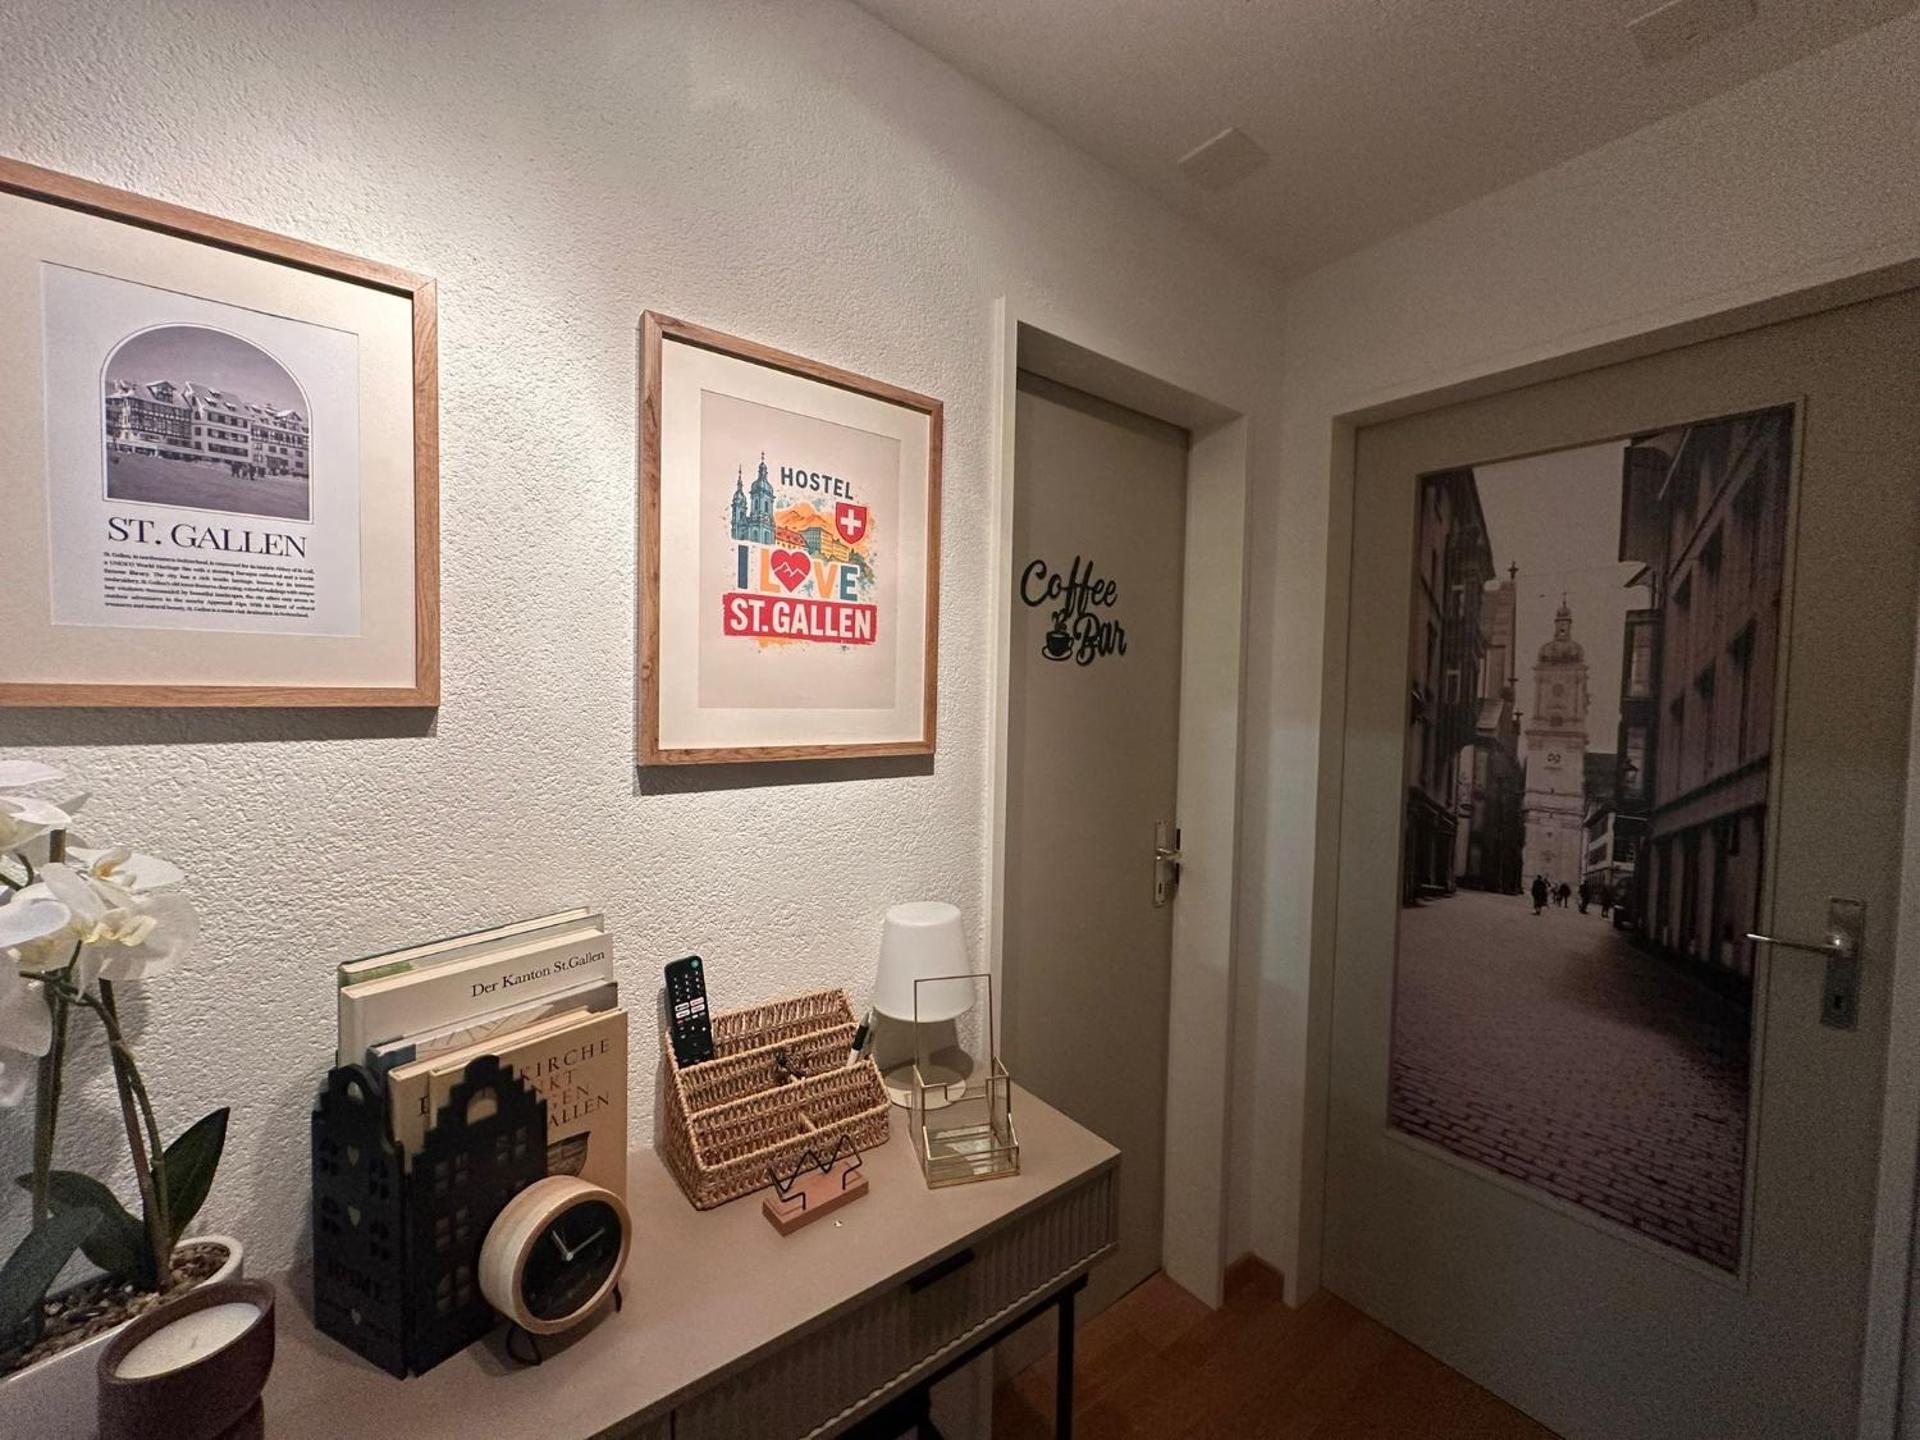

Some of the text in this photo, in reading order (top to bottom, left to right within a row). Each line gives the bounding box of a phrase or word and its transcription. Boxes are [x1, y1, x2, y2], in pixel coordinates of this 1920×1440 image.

[781, 466, 854, 500] HOSTEL
[108, 516, 308, 558] ST. GALLEN
[737, 545, 749, 589] I
[1020, 555, 1118, 618] Coffee
[1073, 613, 1127, 666] Bar
[472, 982, 499, 997] Der
[502, 968, 550, 989] Kanton
[550, 1091, 609, 1127] ALLEN
